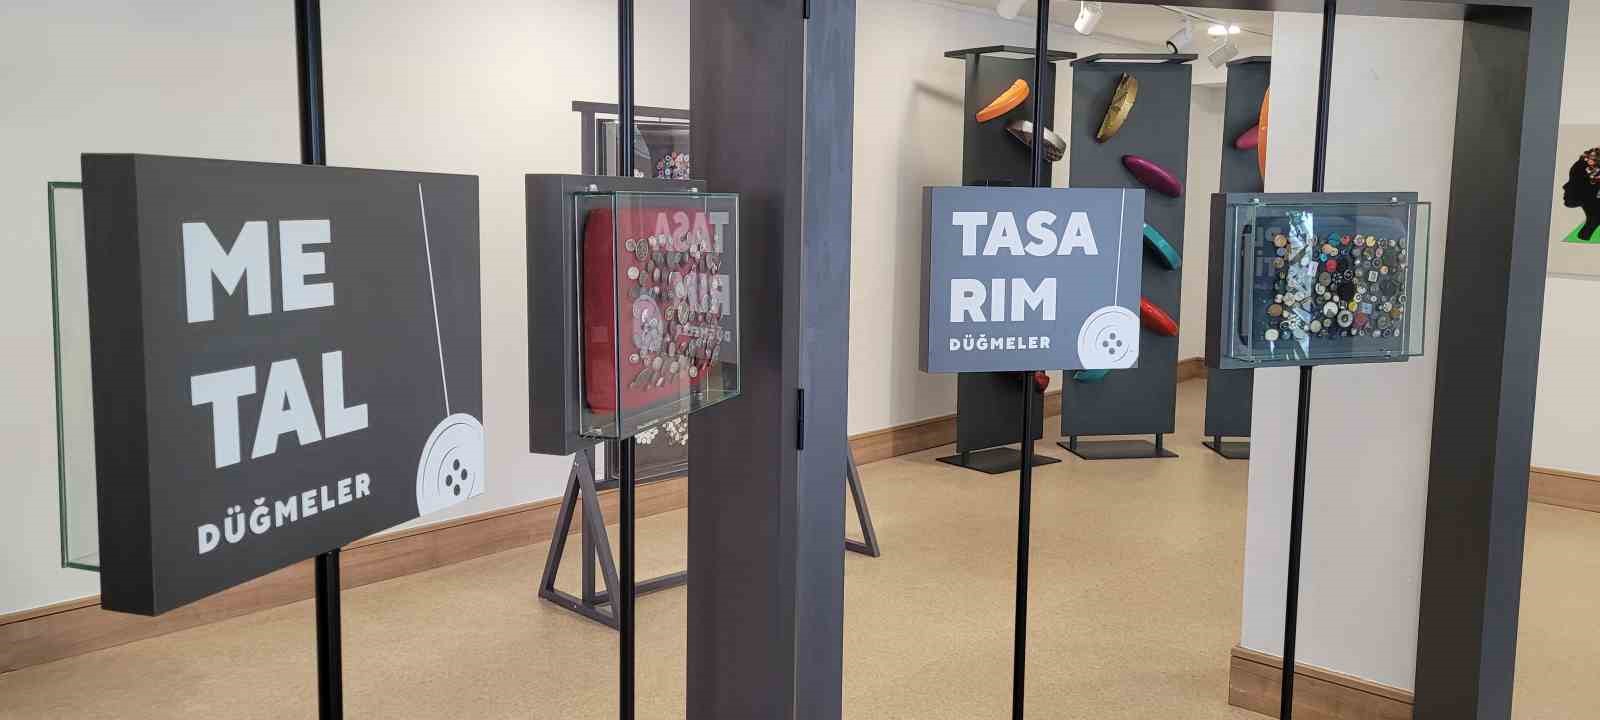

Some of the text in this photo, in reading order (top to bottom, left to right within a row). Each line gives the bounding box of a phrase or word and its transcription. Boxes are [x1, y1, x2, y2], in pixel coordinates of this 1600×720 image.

[951, 210, 1099, 257] TASA
[182, 219, 335, 324] ME
[949, 277, 1057, 323] RIM
[949, 333, 1051, 352] DÜĞMELER
[190, 350, 369, 469] TAL
[197, 472, 371, 555] DÜĞMELER
